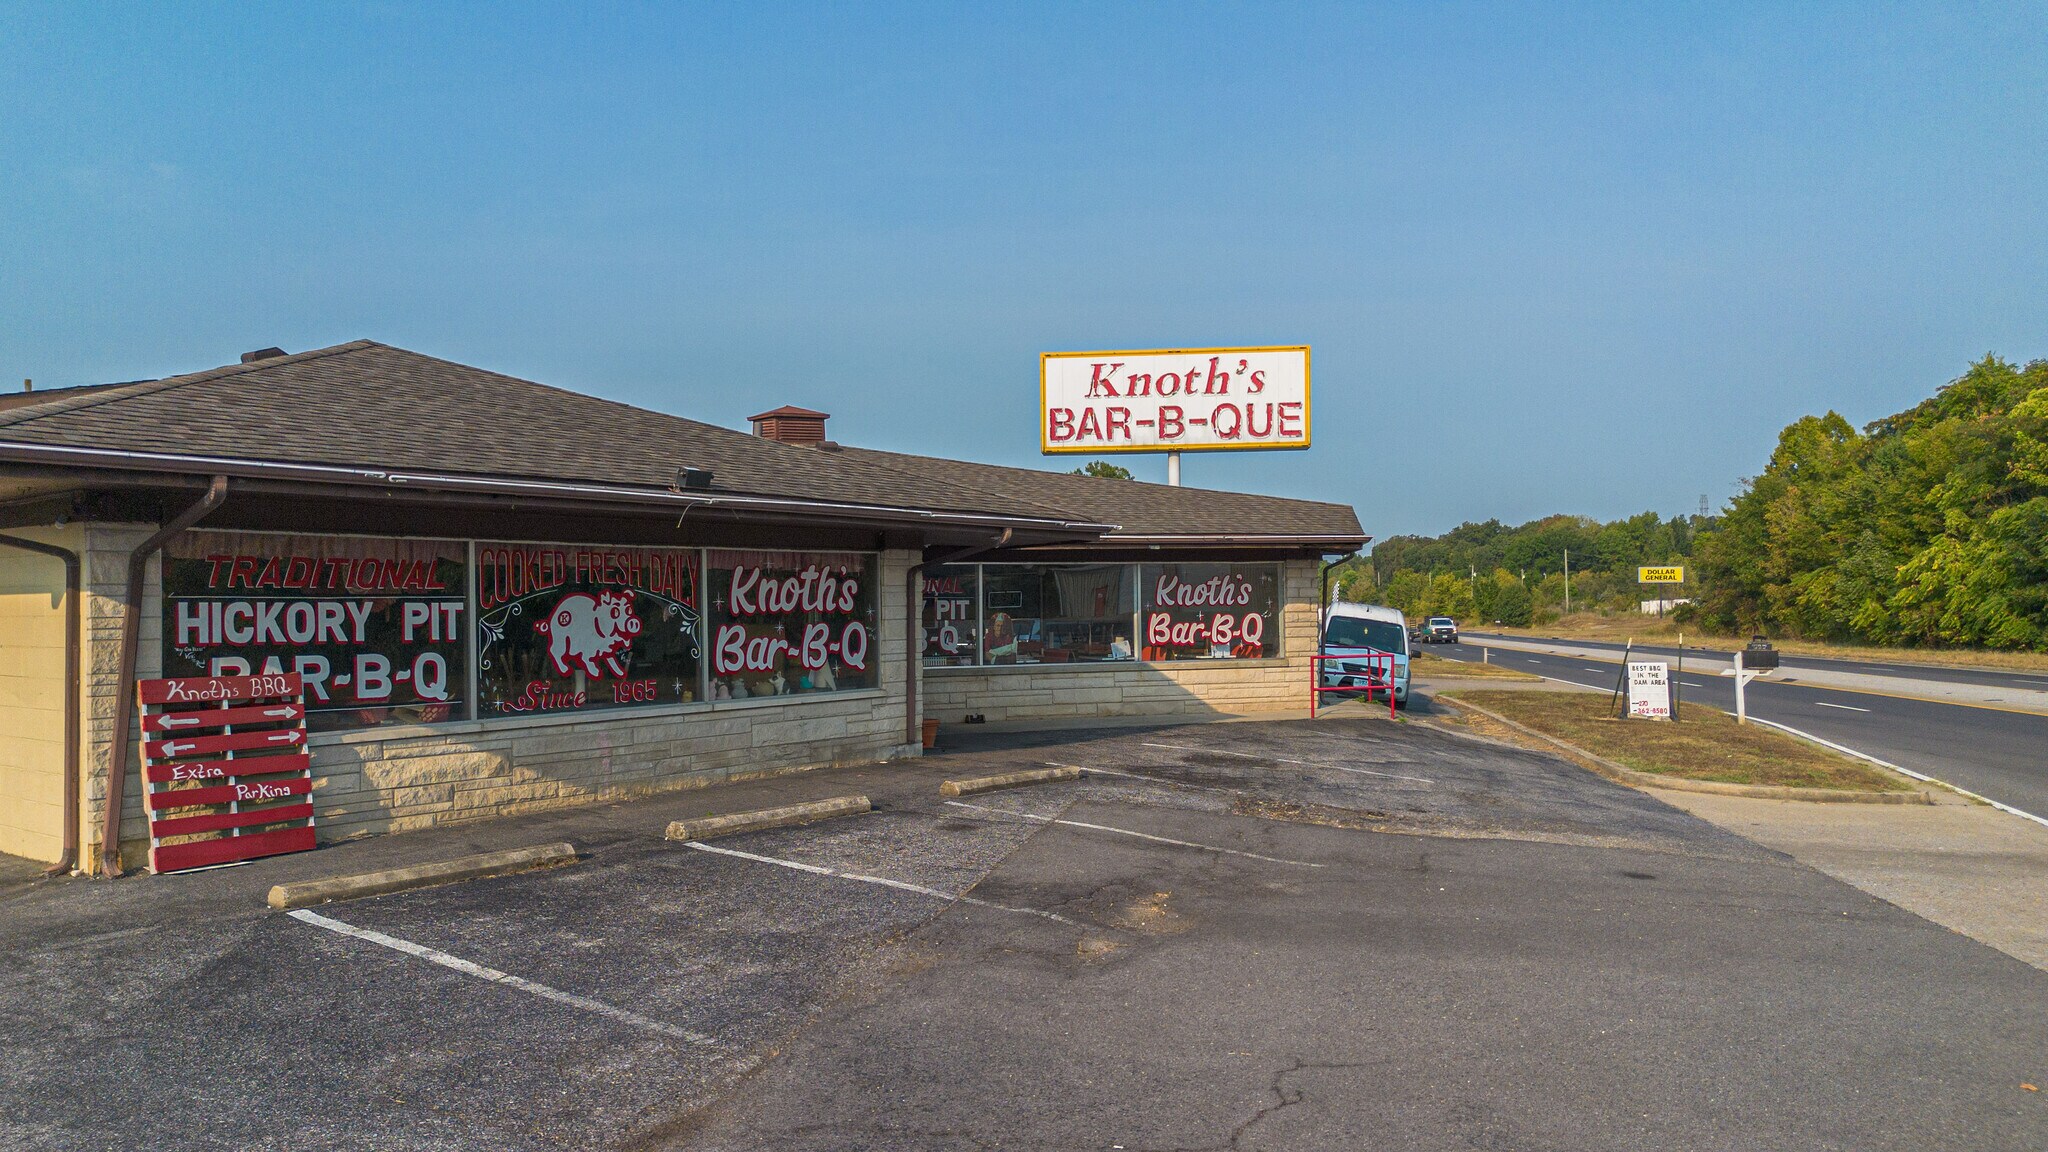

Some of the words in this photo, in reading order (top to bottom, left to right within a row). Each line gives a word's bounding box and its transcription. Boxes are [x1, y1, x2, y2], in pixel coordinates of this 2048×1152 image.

[1084, 356, 1267, 399] Knoth's
[1049, 402, 1303, 442] BAR-B-QUE
[205, 554, 447, 591] TRADITIONAL
[479, 548, 566, 609] COOKED
[575, 551, 642, 588] FRESH
[650, 552, 700, 610] DAILY
[729, 563, 859, 616] Knoth's
[1154, 573, 1253, 608] Knoth's
[174, 601, 374, 646] HICKORY
[402, 602, 464, 645] PIT
[934, 599, 970, 620] PIT
[713, 620, 869, 675] Bar-B-Q
[1147, 612, 1264, 648] Bar-B-Q
[166, 680, 240, 700] Knoth's
[250, 676, 293, 697] BBQ
[502, 679, 587, 711] Since
[612, 679, 657, 703] 1965
[172, 764, 224, 780] Extra
